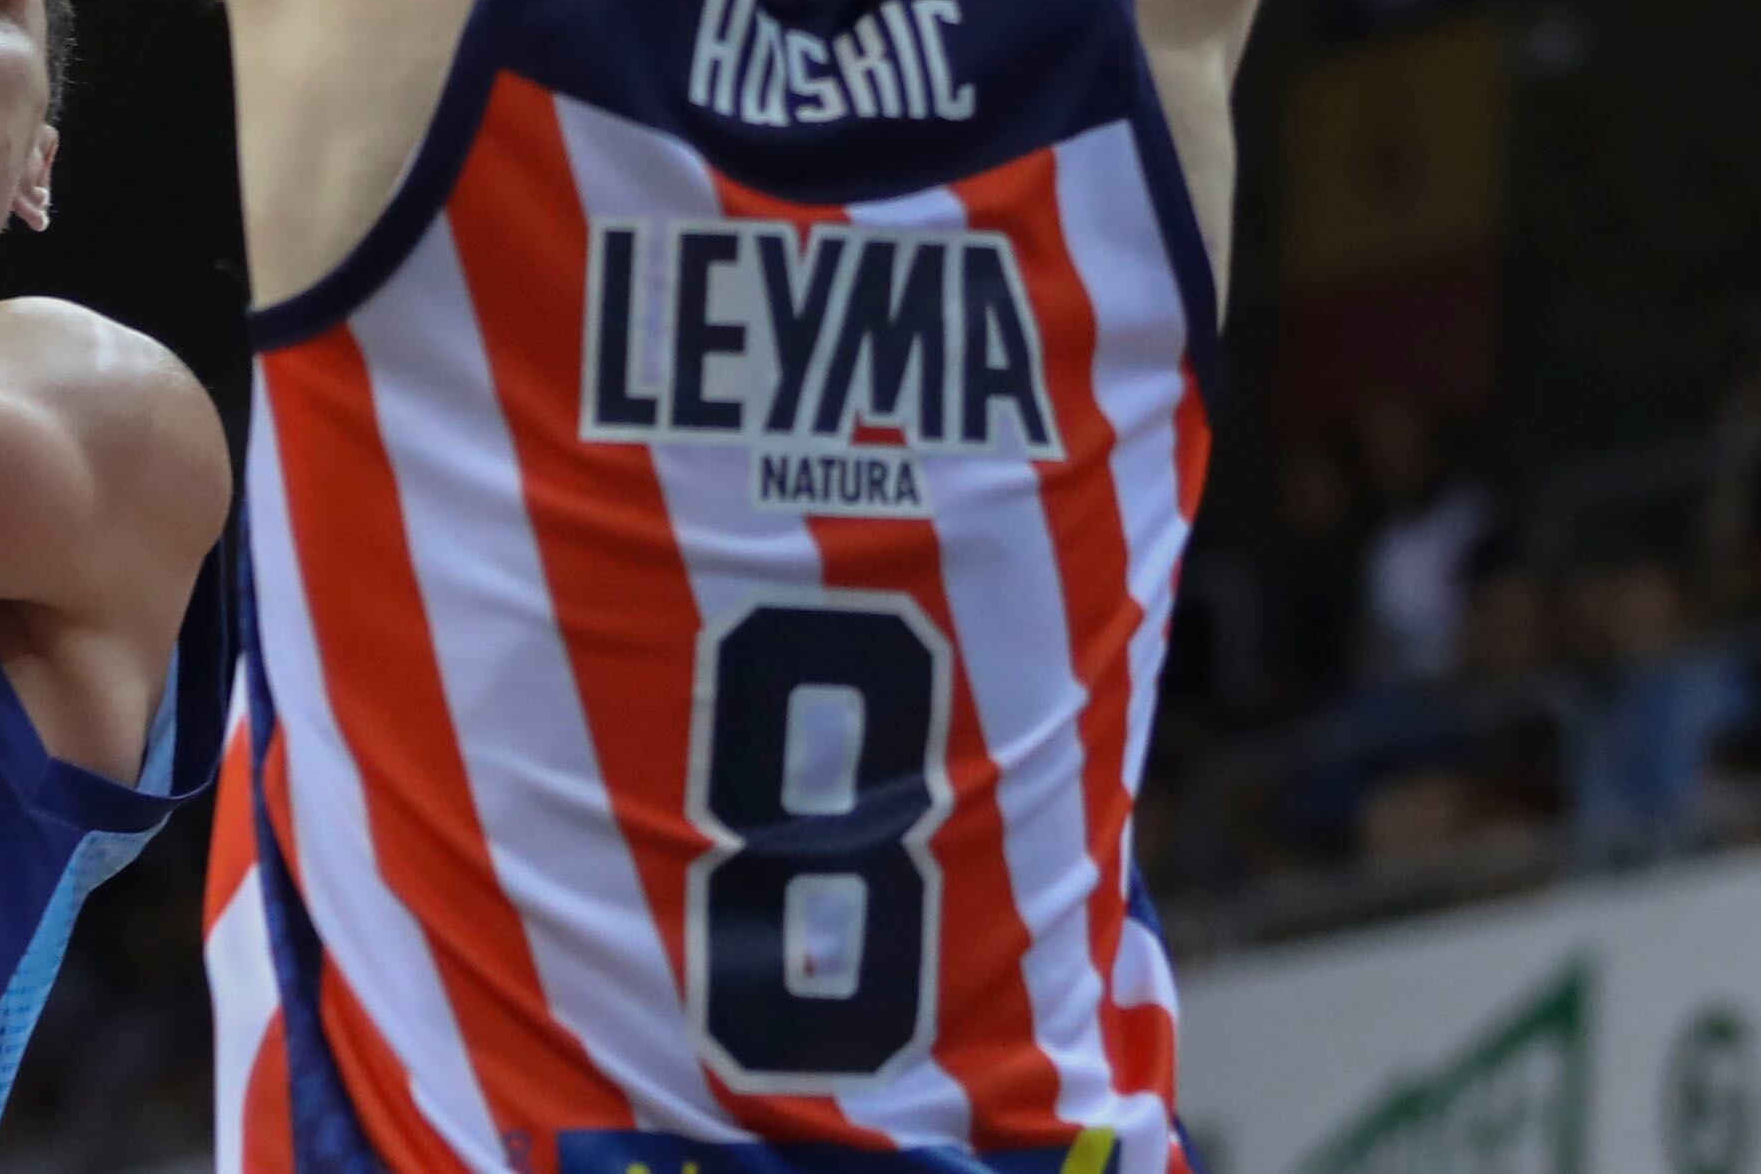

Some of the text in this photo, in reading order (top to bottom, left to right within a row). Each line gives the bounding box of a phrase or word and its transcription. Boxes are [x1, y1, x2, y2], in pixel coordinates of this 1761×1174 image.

[584, 223, 1061, 454] LEYMA
[758, 453, 923, 508] NATURA
[694, 596, 944, 1084] 8
